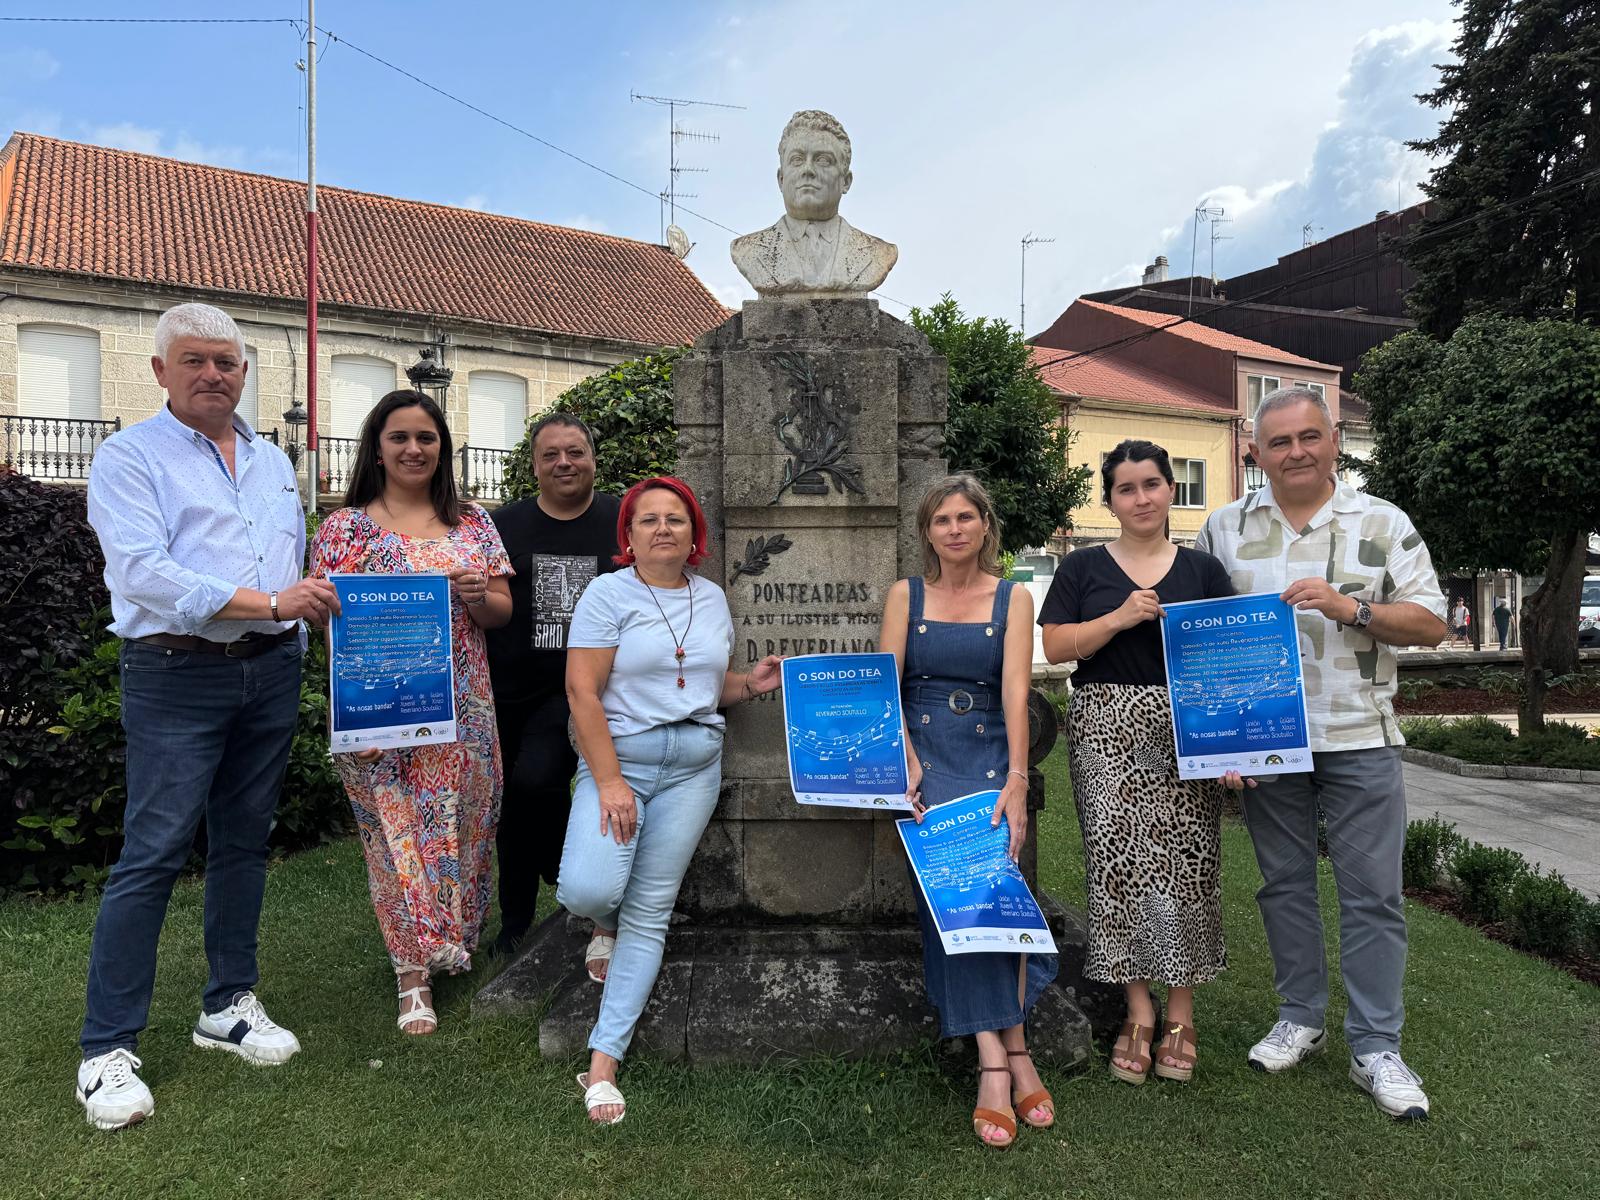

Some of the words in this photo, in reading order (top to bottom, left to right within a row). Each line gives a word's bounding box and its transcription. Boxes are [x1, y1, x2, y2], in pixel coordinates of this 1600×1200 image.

[348, 593, 357, 602] O
[361, 593, 387, 602] SON
[390, 592, 408, 601] DO
[411, 592, 434, 601] TEA
[753, 582, 869, 603] PONTEAREAS
[742, 615, 752, 625] A
[757, 614, 775, 625] SU
[781, 613, 840, 625] ILUSTRE
[1181, 621, 1191, 630] O
[1195, 617, 1223, 629] SON
[1226, 614, 1247, 625] DO
[1250, 610, 1277, 622] TEA
[534, 623, 563, 649] SAXO
[798, 673, 808, 681] O
[810, 671, 835, 680] SON
[838, 670, 856, 679] DO
[859, 668, 881, 677] TEA
[374, 702, 395, 710] bandas"
[1217, 728, 1240, 737] bandas"
[919, 830, 928, 838] O
[930, 818, 956, 834] SON
[957, 811, 976, 824] DO
[958, 904, 974, 912] nosas
[975, 902, 995, 910] bandas"
